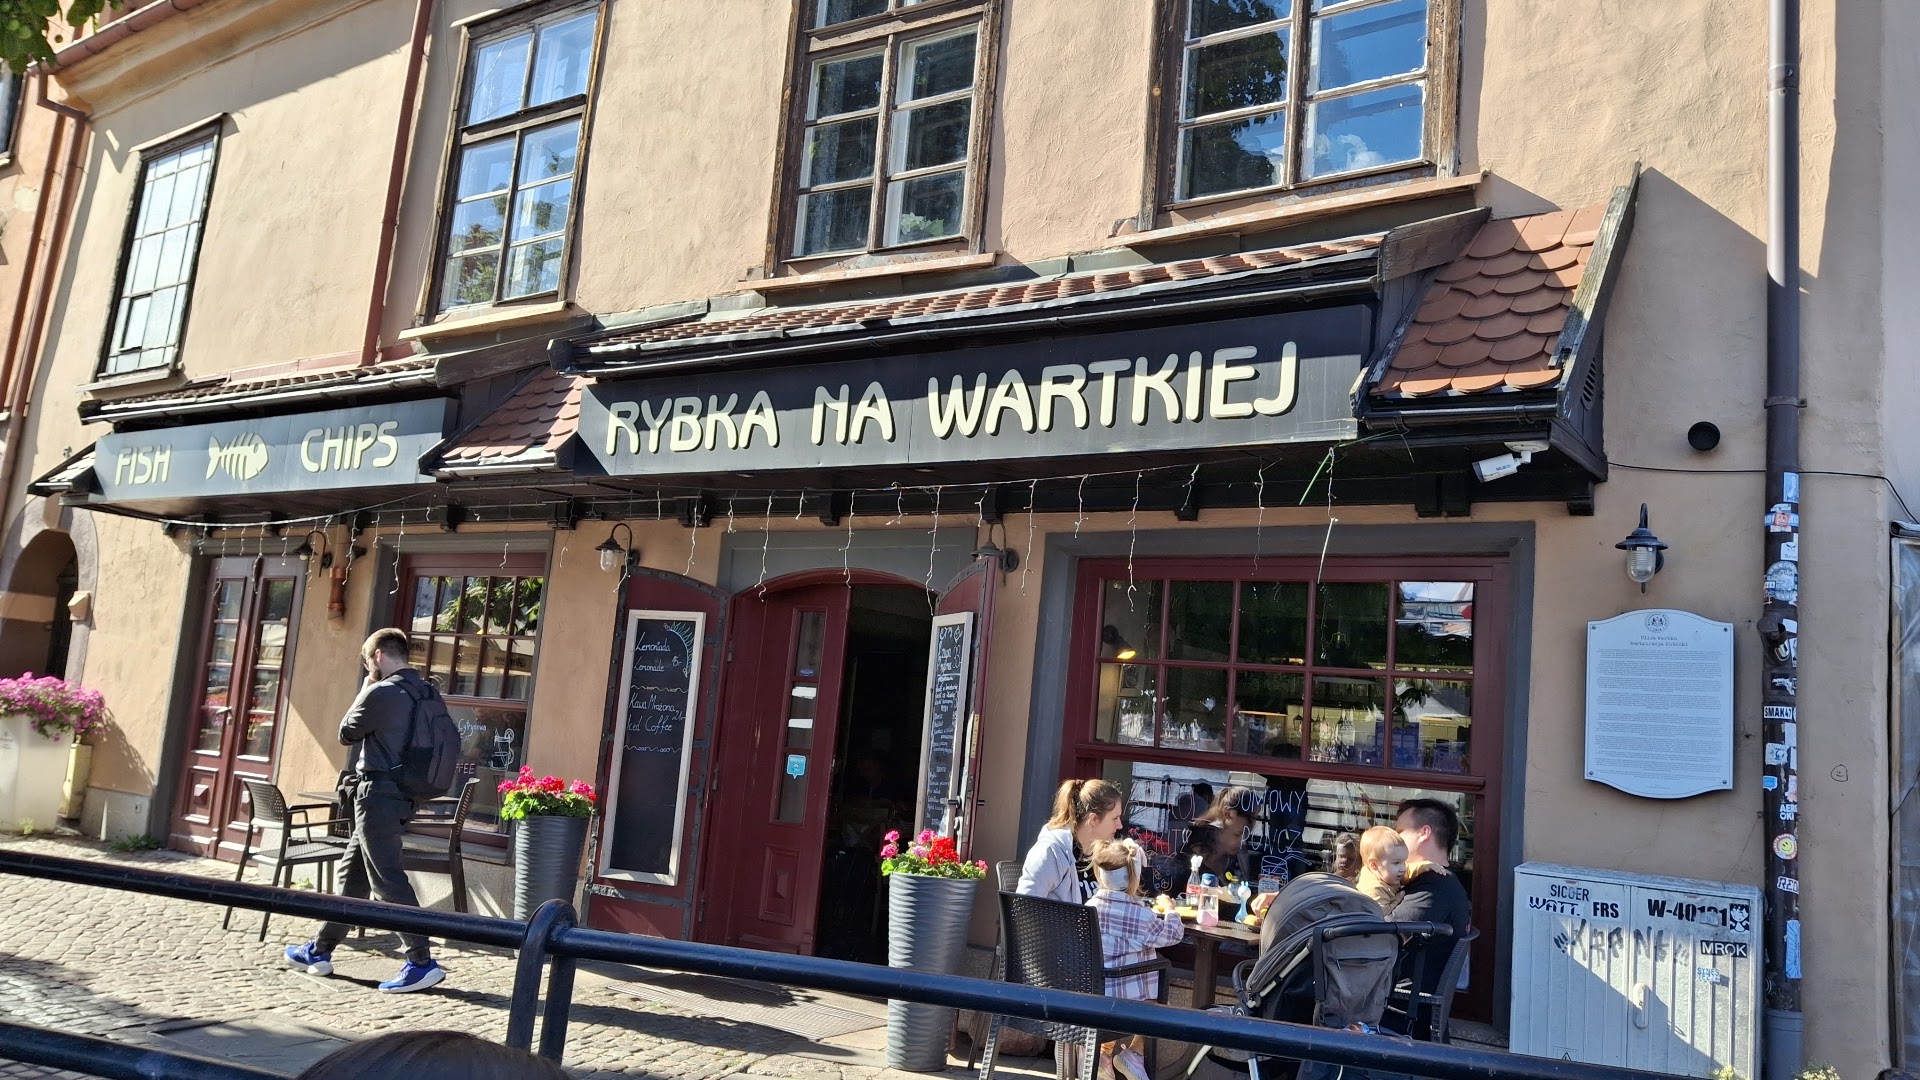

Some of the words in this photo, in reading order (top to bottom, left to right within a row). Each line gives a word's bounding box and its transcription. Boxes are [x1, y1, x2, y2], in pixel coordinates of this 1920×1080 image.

[605, 390, 780, 455] RYBKA
[811, 381, 896, 446] NA
[927, 341, 1299, 439] WARTKIEJ
[114, 444, 172, 486] FISH
[300, 420, 400, 473] CHIPS
[635, 631, 671, 652] Lemoniada
[633, 655, 665, 672] Lemonade
[629, 692, 647, 709] Kawa
[626, 713, 643, 731] Iced
[644, 714, 673, 735] Coffee
[1592, 901, 1620, 919] FRS
[1701, 941, 1748, 957] MROK
